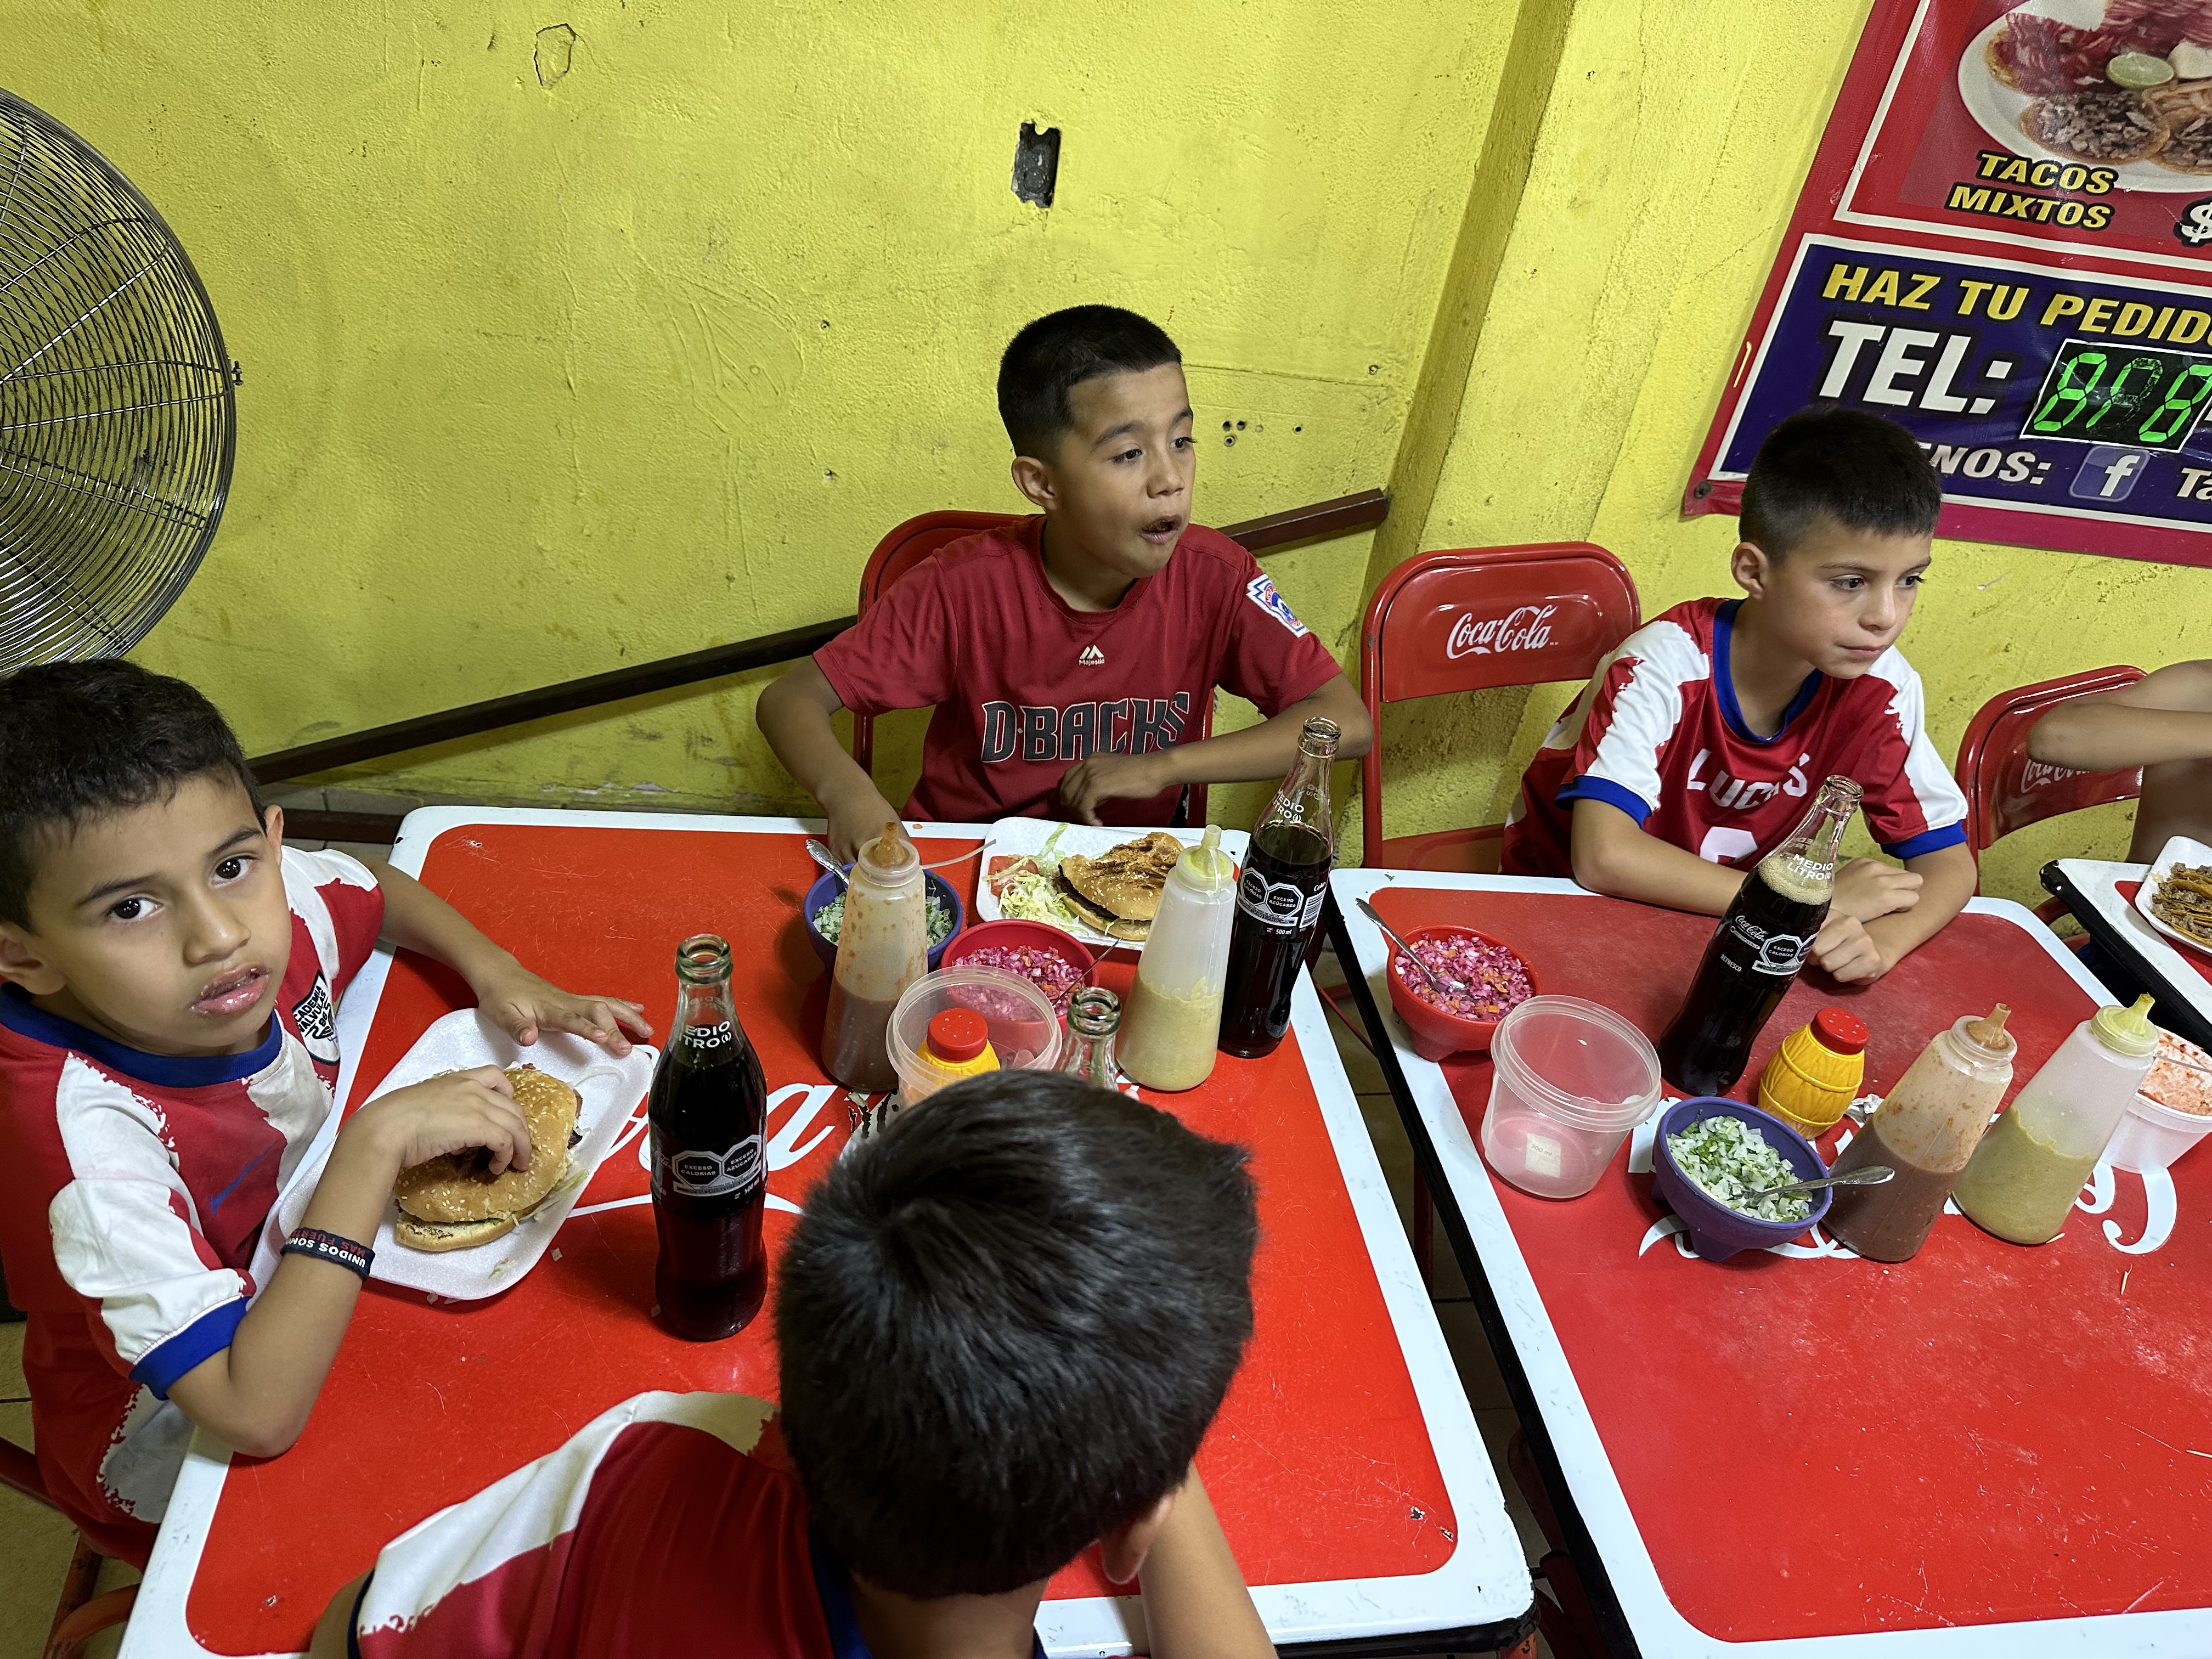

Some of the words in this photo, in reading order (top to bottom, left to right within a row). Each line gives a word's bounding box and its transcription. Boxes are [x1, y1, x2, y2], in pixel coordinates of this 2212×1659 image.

[1979, 153, 2114, 194] TACOS
[1949, 187, 2111, 228] MIXTOS
[1822, 264, 1941, 309] HAZ
[1957, 280, 2029, 320] TU
[2040, 294, 2212, 346] PEDID
[1819, 320, 2012, 414] TEL:
[1916, 442, 2052, 485] NOS:
[1446, 604, 1558, 659] Coca-Cola
[1079, 658, 1105, 667] Majestic
[1793, 853, 1833, 871] MEDIO
[1246, 879, 1261, 893] EXCESO
[1268, 899, 1296, 908] AZÚCARES
[1735, 915, 1769, 941] Coca-Cola
[1720, 953, 1742, 972] REFRESCO
[294, 985, 322, 1022] CADEMIA
[685, 1020, 730, 1037] EDIO
[730, 1148, 754, 1165] EXCESO
[285, 1237, 315, 1249] SOM
[341, 1242, 366, 1257] MAS
[318, 1243, 366, 1268] UNIDOS
